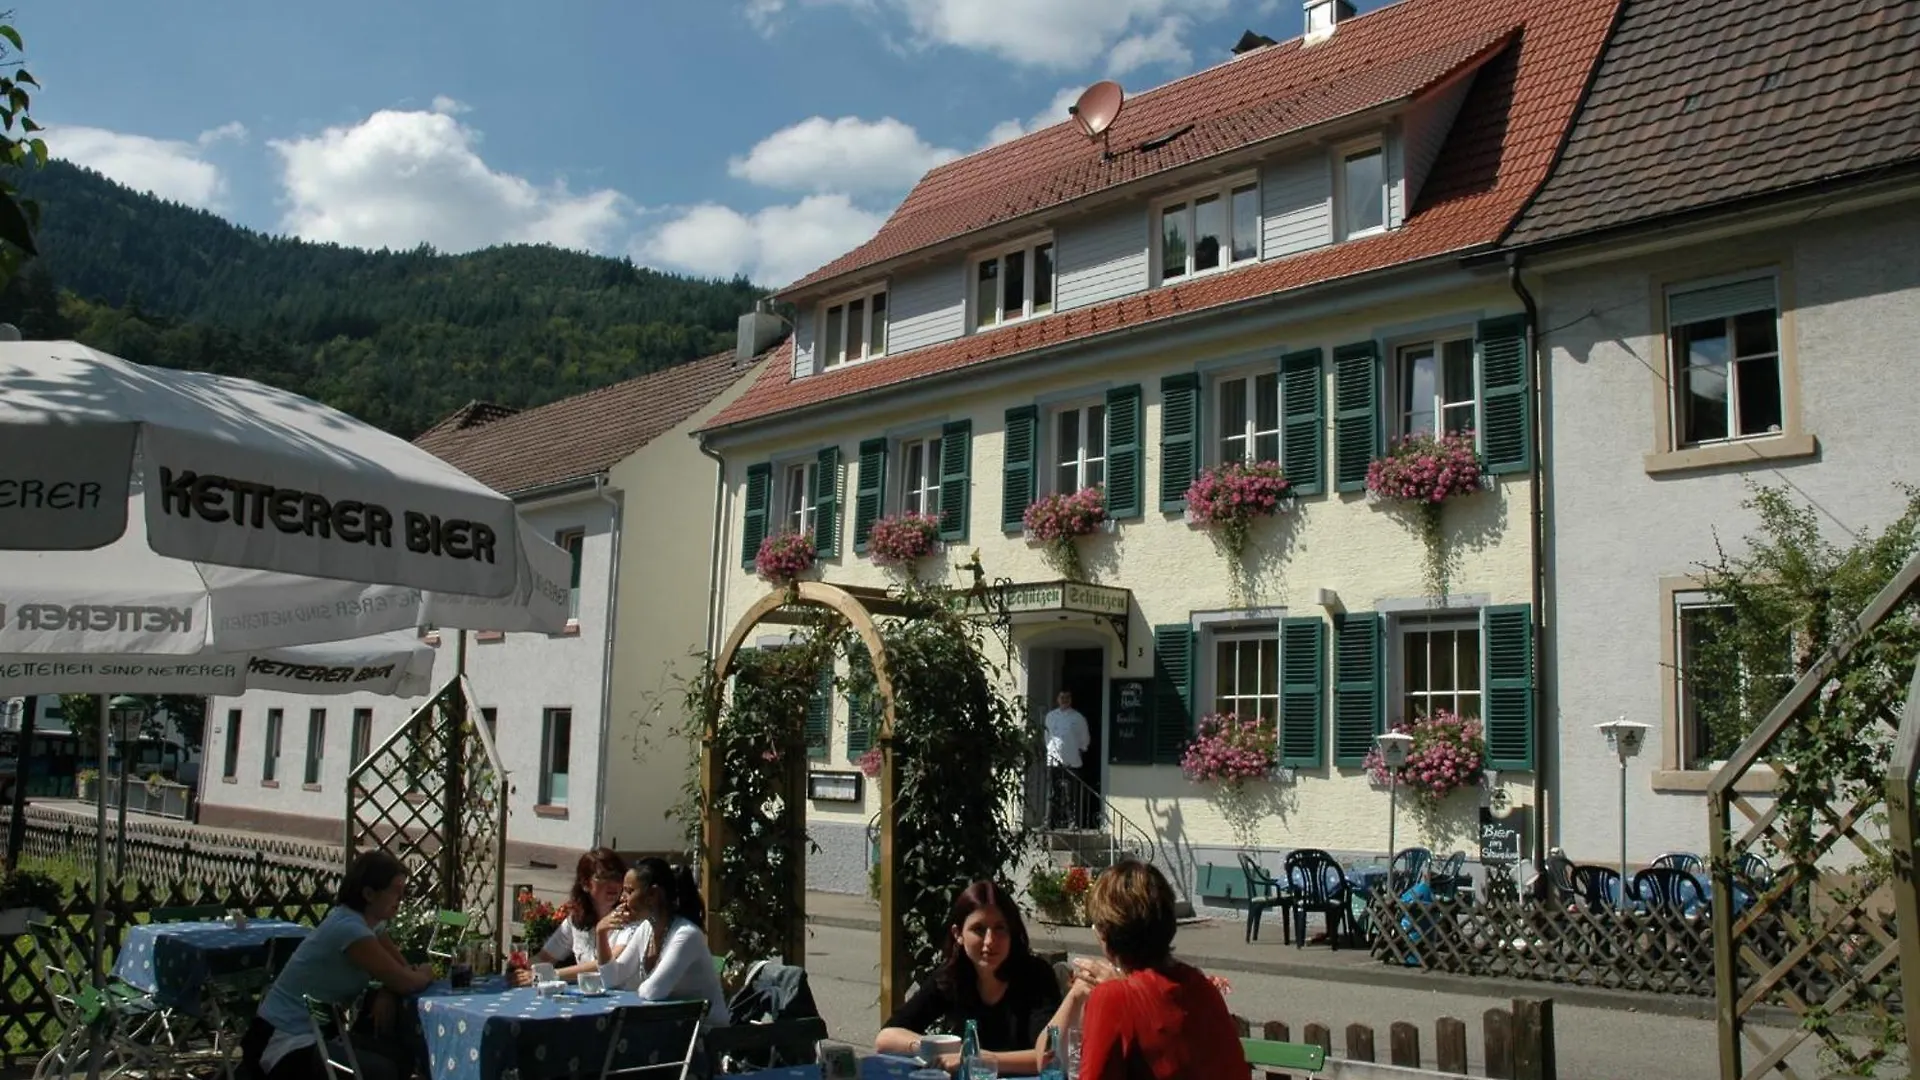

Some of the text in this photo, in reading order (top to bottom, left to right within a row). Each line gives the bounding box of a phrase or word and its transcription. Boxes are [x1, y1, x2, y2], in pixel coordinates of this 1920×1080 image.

[159, 467, 496, 564] KETTERER BIER
[99, 664, 144, 677] SIND
[147, 664, 235, 678] NETTERER
[247, 656, 355, 682] KETTERER
[1481, 823, 1515, 839] Bier
